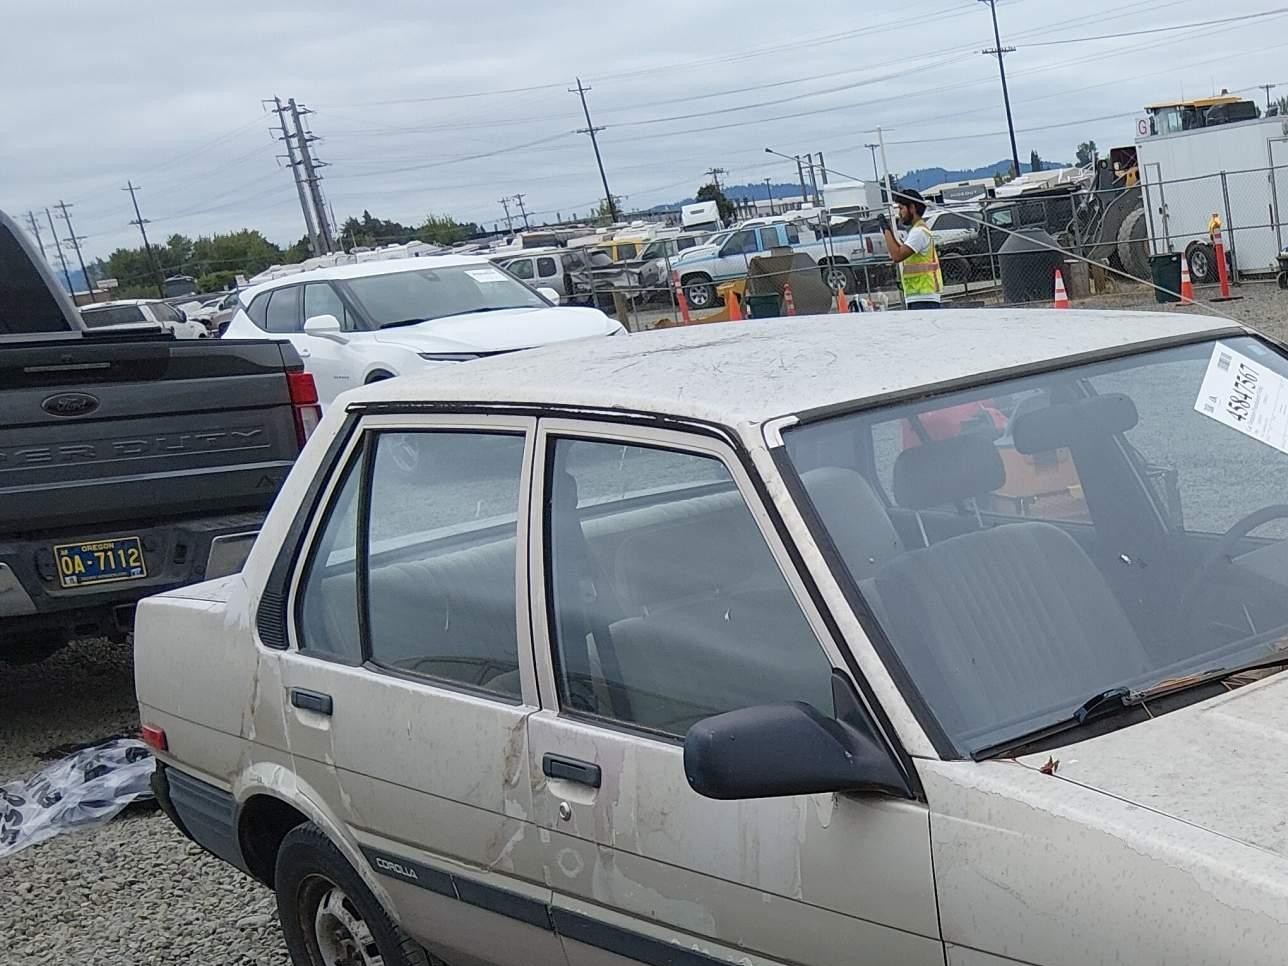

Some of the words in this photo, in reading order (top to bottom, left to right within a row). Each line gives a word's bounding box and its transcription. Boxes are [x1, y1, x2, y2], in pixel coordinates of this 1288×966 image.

[1138, 119, 1148, 135] G
[1226, 363, 1259, 421] 45847567
[56, 397, 88, 411] Ford
[111, 428, 263, 455] DUTY
[81, 543, 114, 552] OREGON
[376, 857, 418, 879] COROLLA
